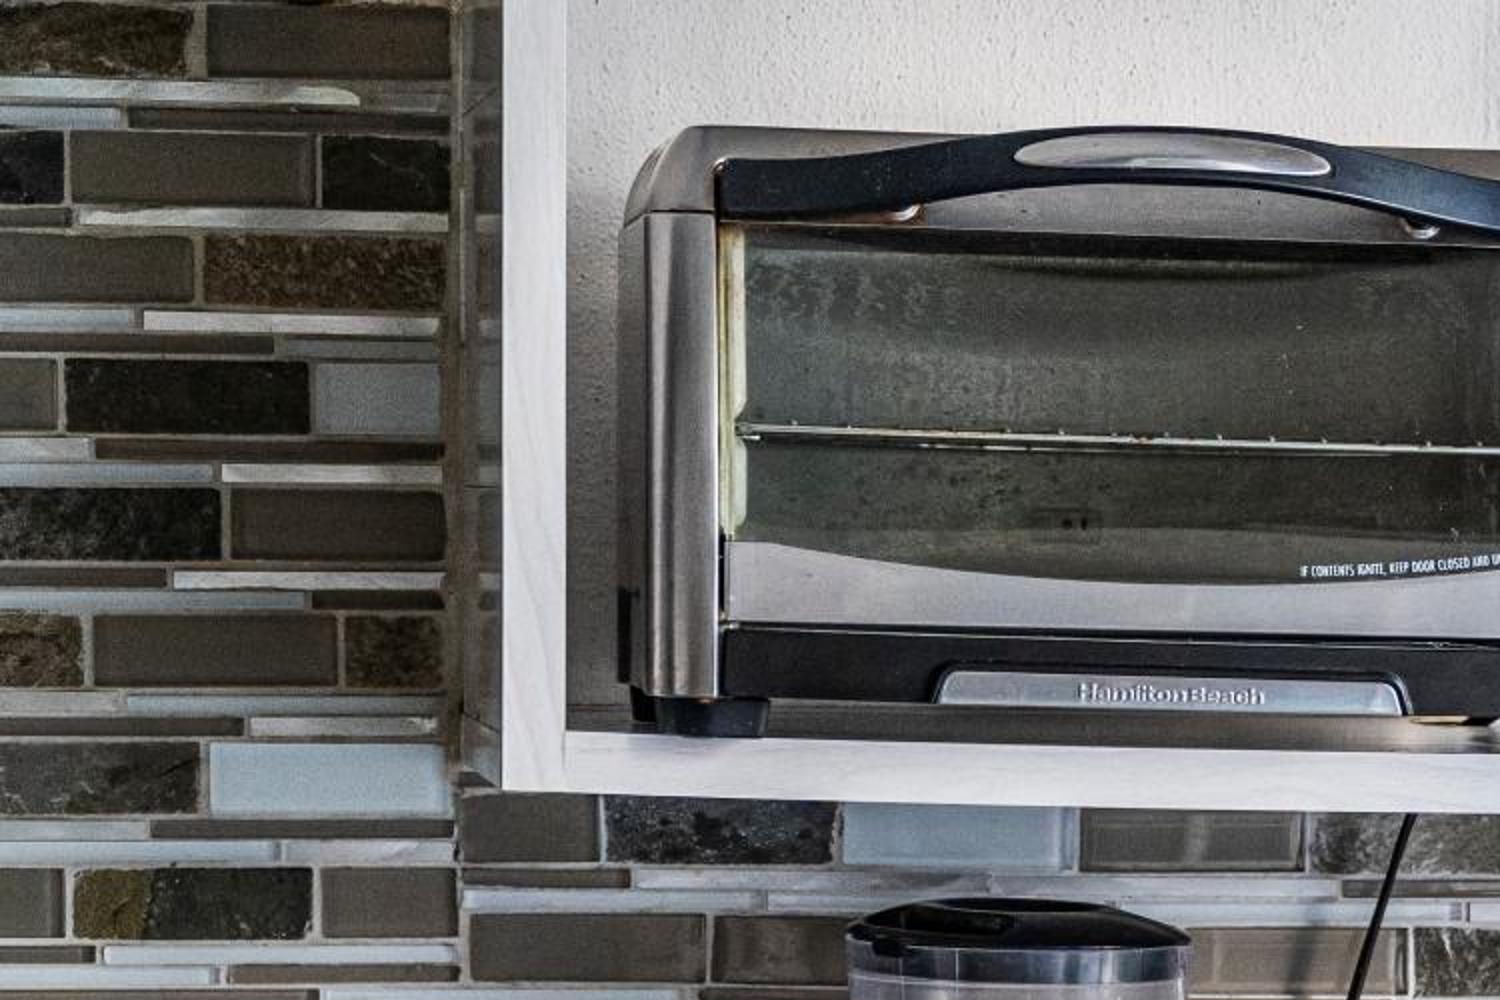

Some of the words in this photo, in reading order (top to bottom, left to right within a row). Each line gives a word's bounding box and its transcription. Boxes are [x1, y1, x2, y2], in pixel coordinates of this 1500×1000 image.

[1311, 564, 1355, 577] CONTENTS
[1389, 561, 1409, 573] KEEP
[1411, 559, 1436, 573] DOOR
[1437, 556, 1471, 571] CLOSED
[1472, 555, 1490, 567] AND
[1078, 682, 1187, 705] Hamilton
